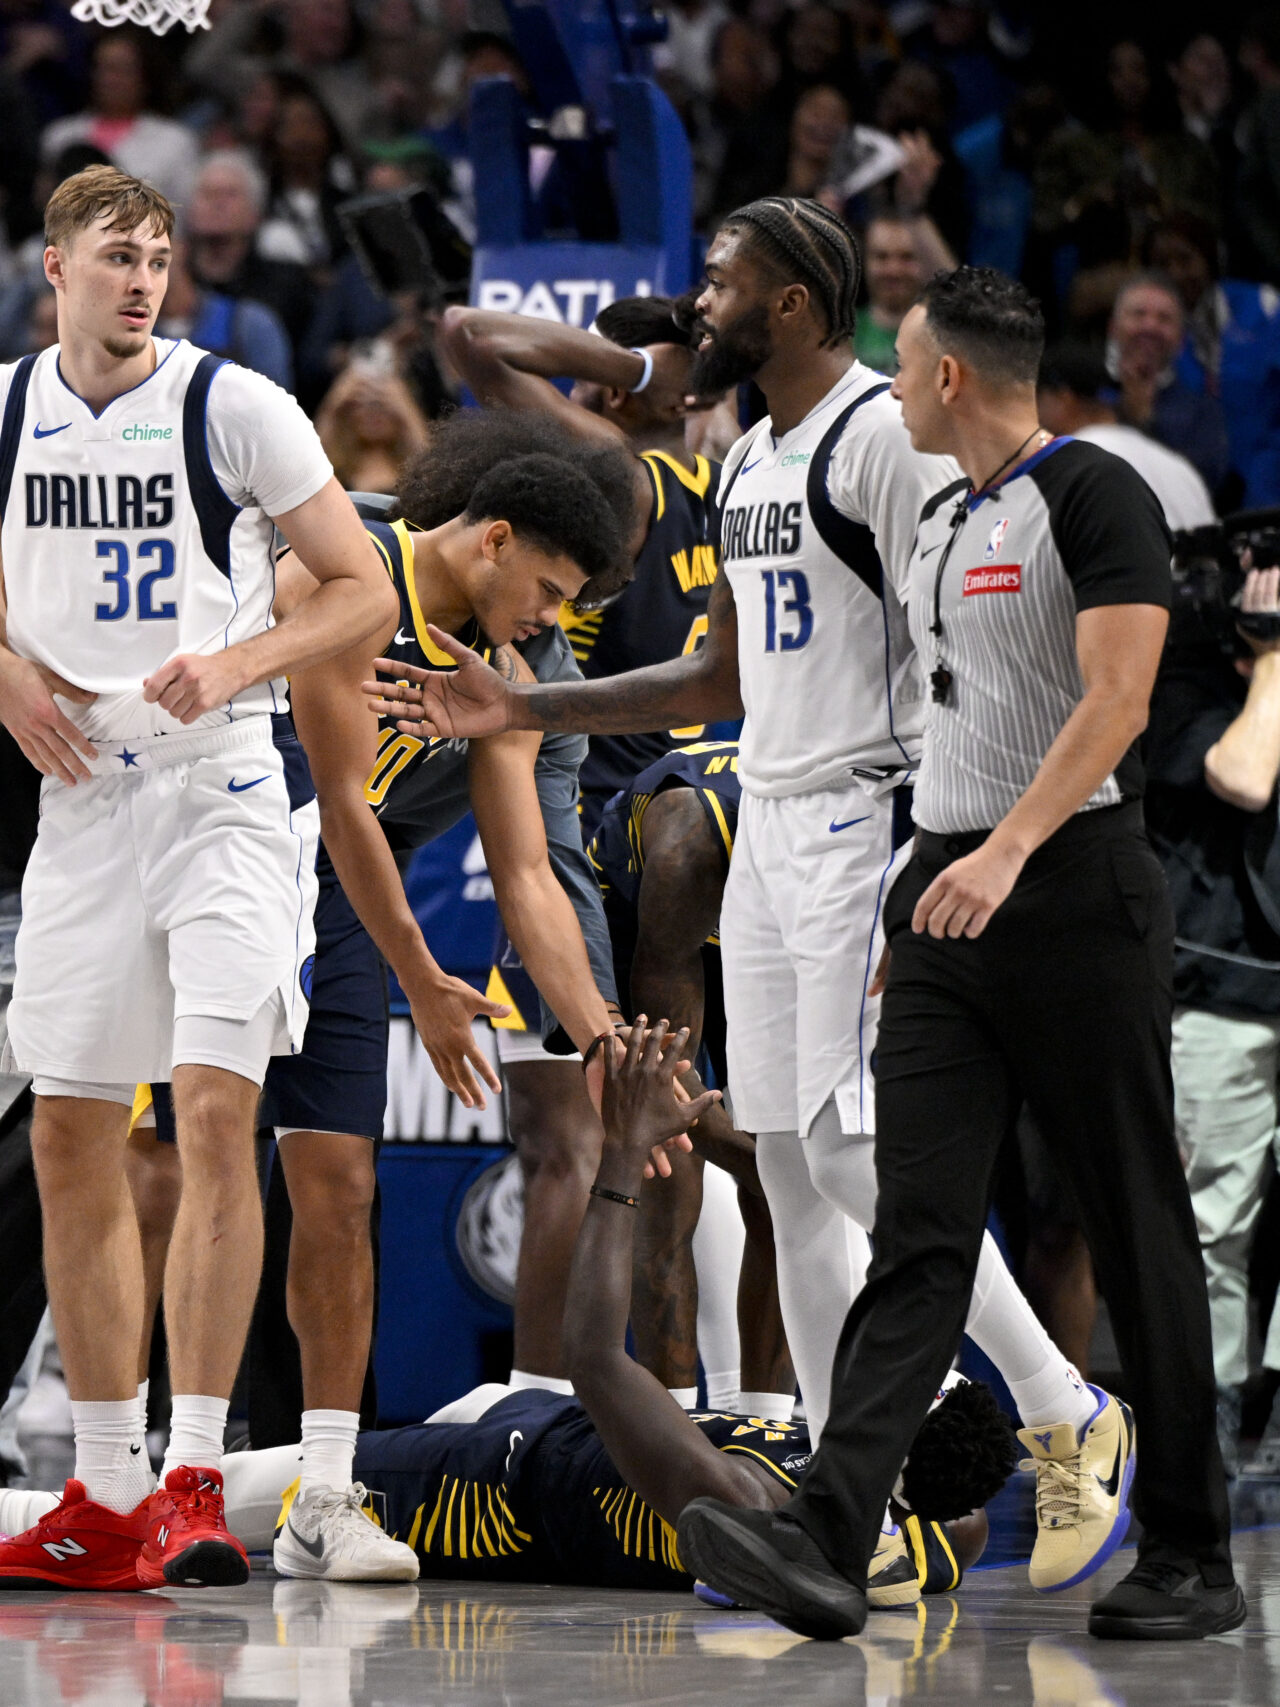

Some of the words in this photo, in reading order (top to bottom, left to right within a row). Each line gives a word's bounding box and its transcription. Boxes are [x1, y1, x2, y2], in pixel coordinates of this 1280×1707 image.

[122, 424, 173, 441] chime
[781, 450, 811, 467] chime
[24, 472, 175, 530] DALLAS
[723, 501, 804, 561] DALLAS
[94, 538, 179, 622] 32
[963, 571, 1019, 592] Emirates
[761, 568, 815, 653] 13
